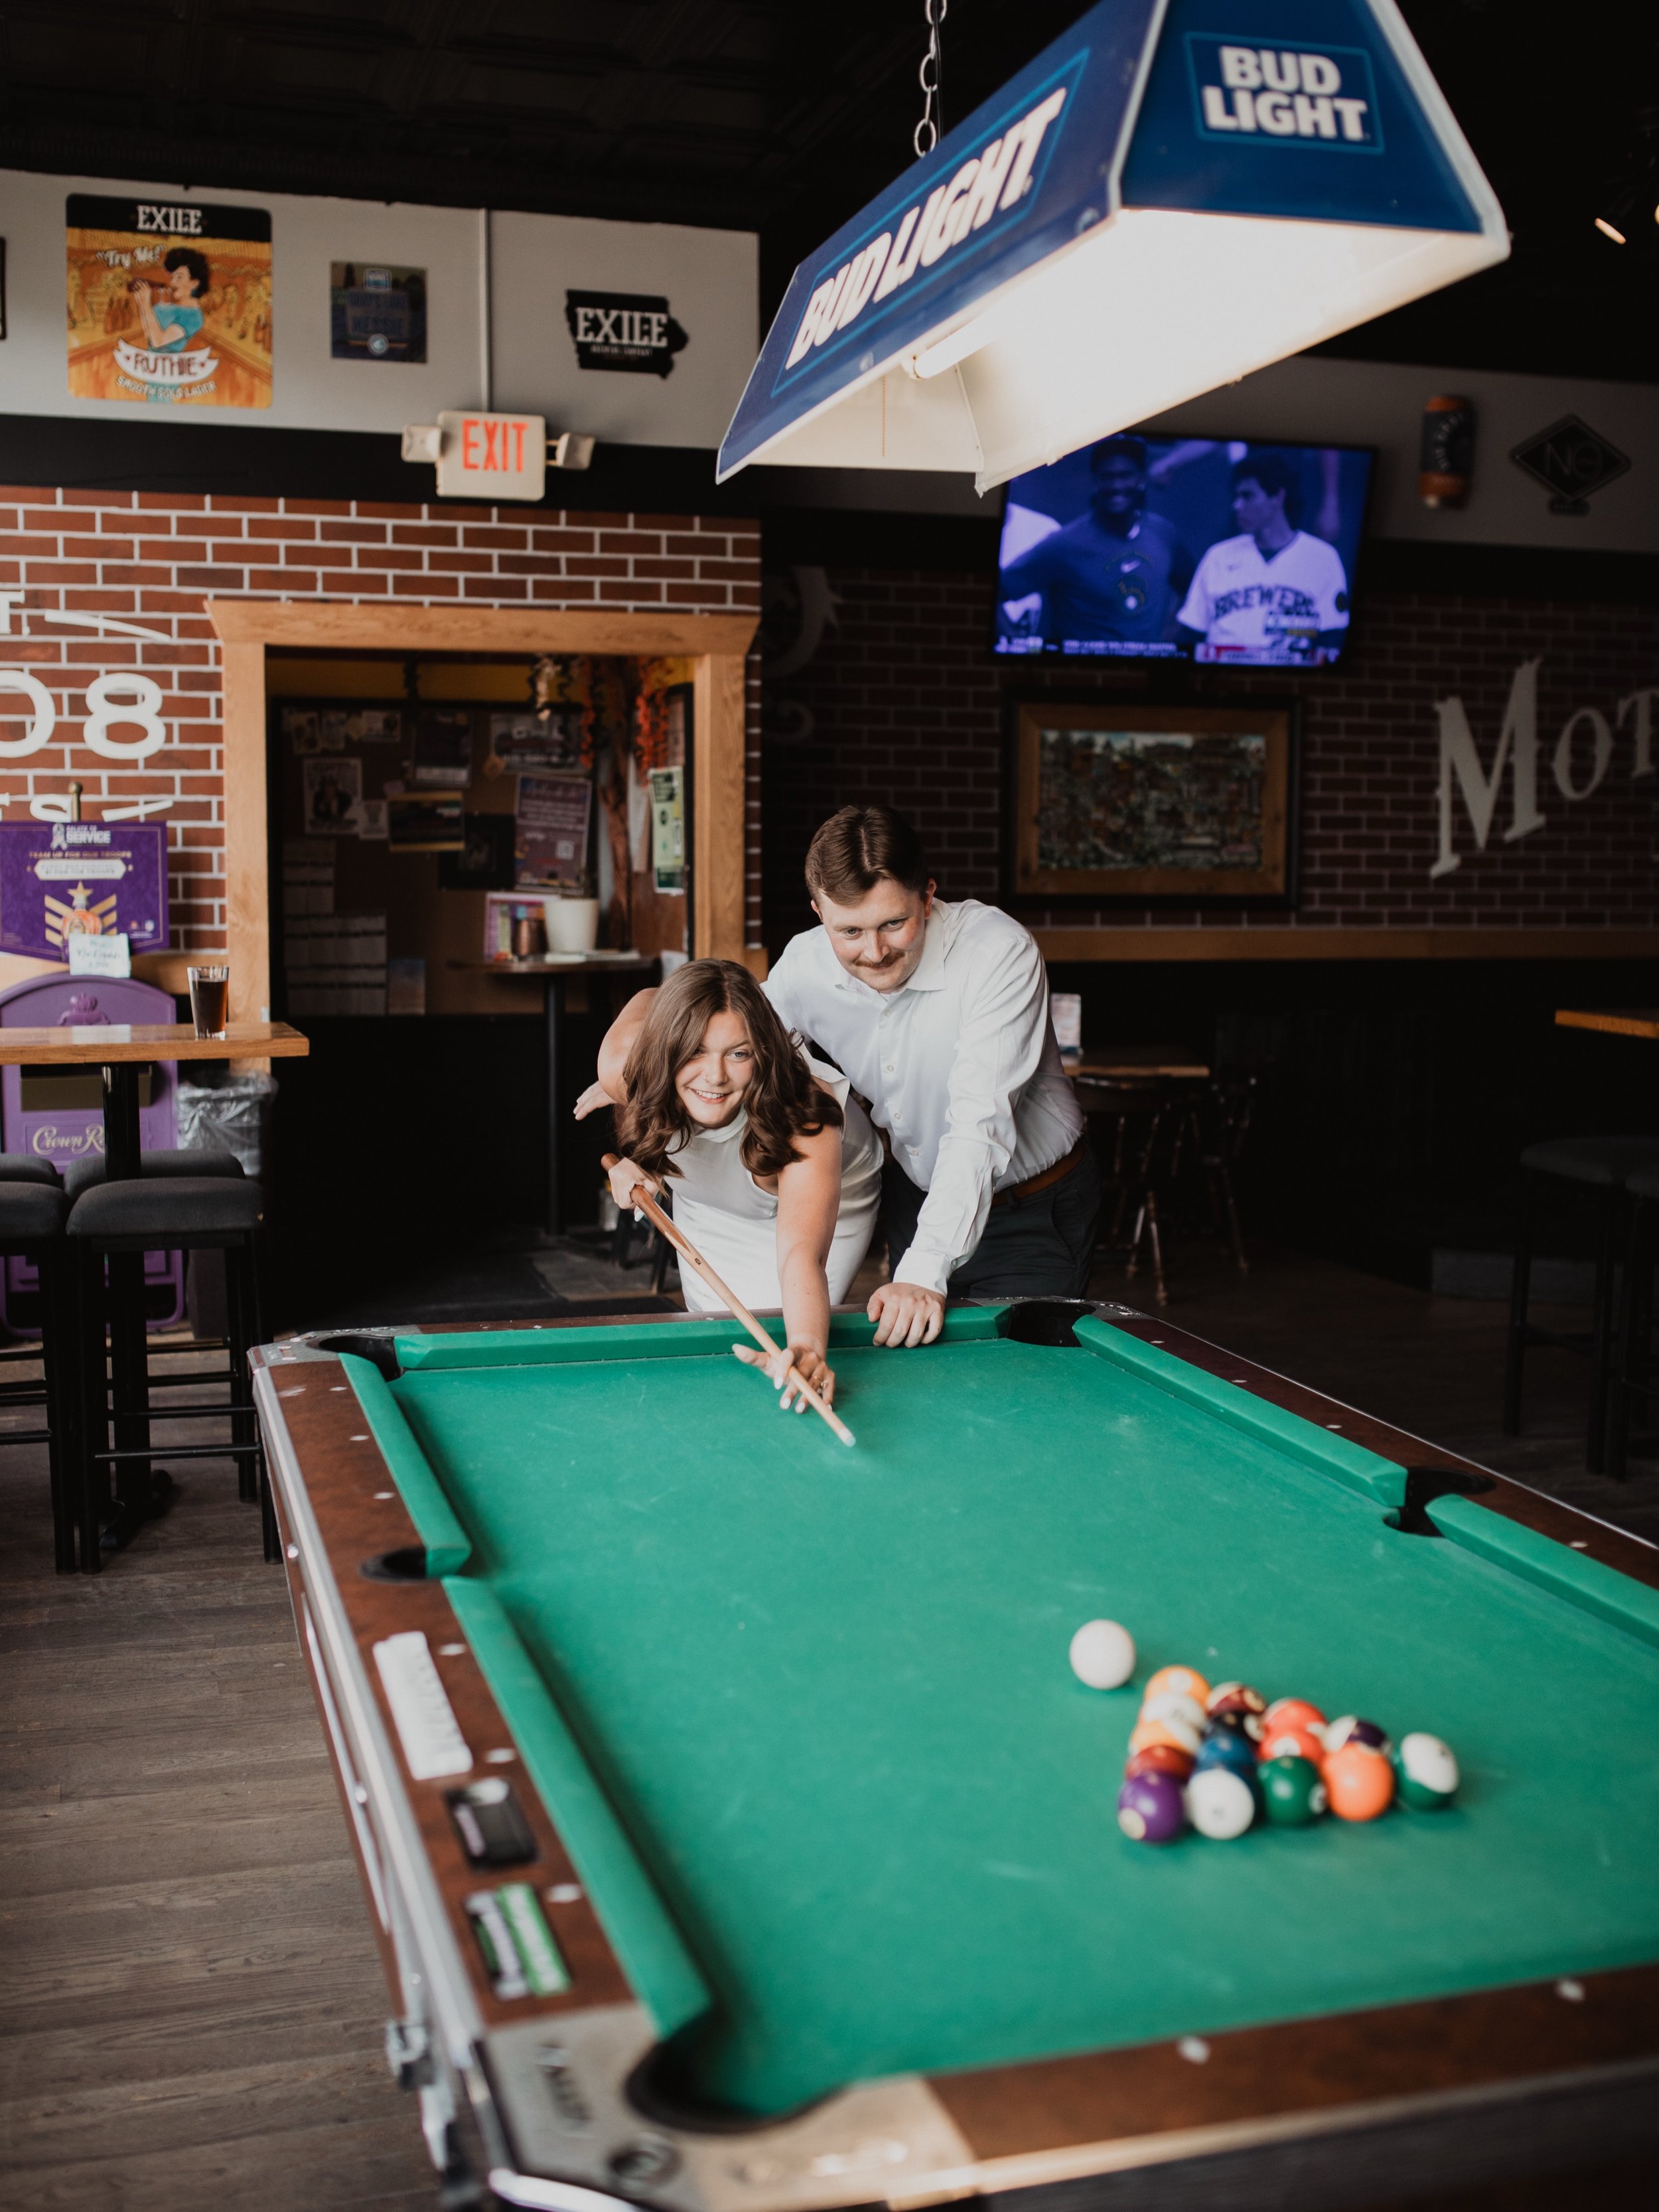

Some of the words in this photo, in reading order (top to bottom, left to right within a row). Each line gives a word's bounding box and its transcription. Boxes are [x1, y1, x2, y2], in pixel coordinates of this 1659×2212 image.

[1219, 45, 1342, 97] BUD
[1202, 85, 1368, 141] LIGHT
[137, 205, 202, 234] EXILE
[785, 232, 892, 370] BUD
[873, 88, 1066, 303] LIGHT
[575, 307, 668, 347] EXILE
[135, 352, 197, 377] RUTHIE
[461, 419, 530, 474] EXIT
[66, 830, 111, 844] SERVICE
[33, 1125, 83, 1155] Crown
